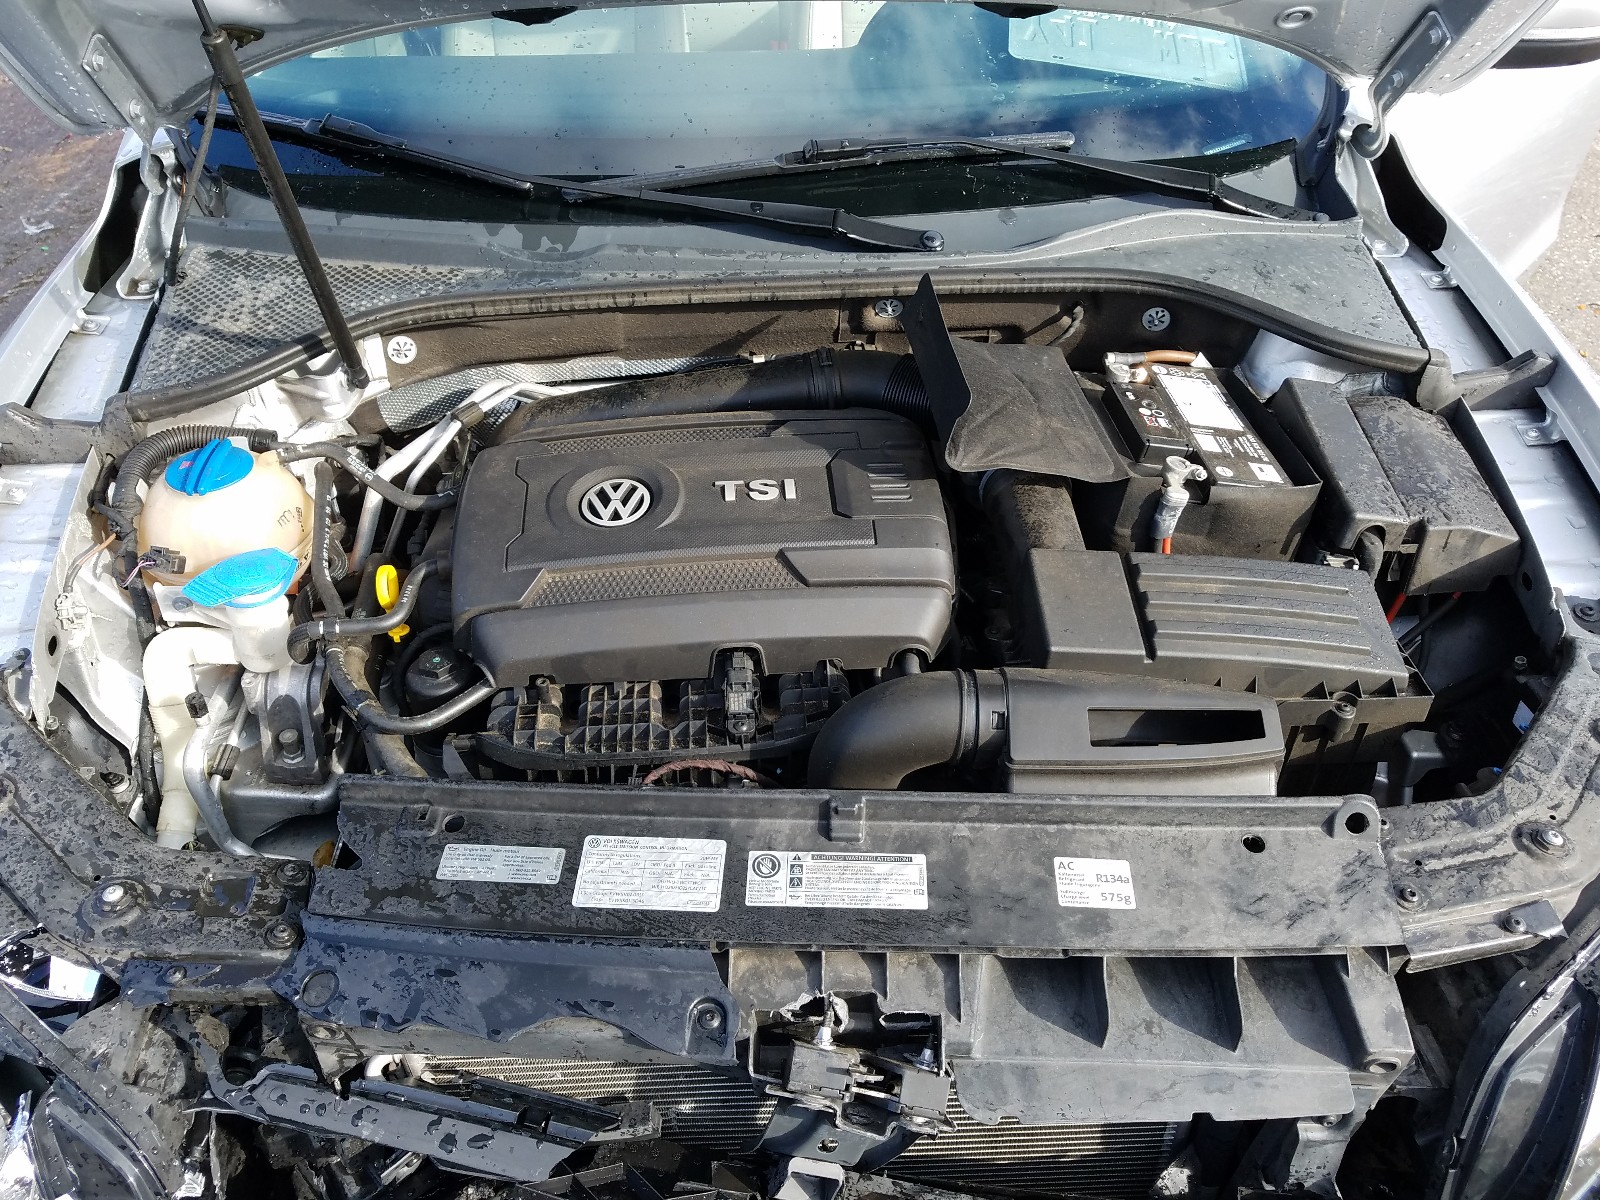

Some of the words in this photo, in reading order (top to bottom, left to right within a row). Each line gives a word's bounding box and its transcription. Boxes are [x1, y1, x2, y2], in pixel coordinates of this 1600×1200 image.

[714, 478, 797, 502] TSI
[1058, 861, 1075, 870] AC
[1096, 873, 1130, 884] R134a
[1101, 892, 1132, 905] 575g
